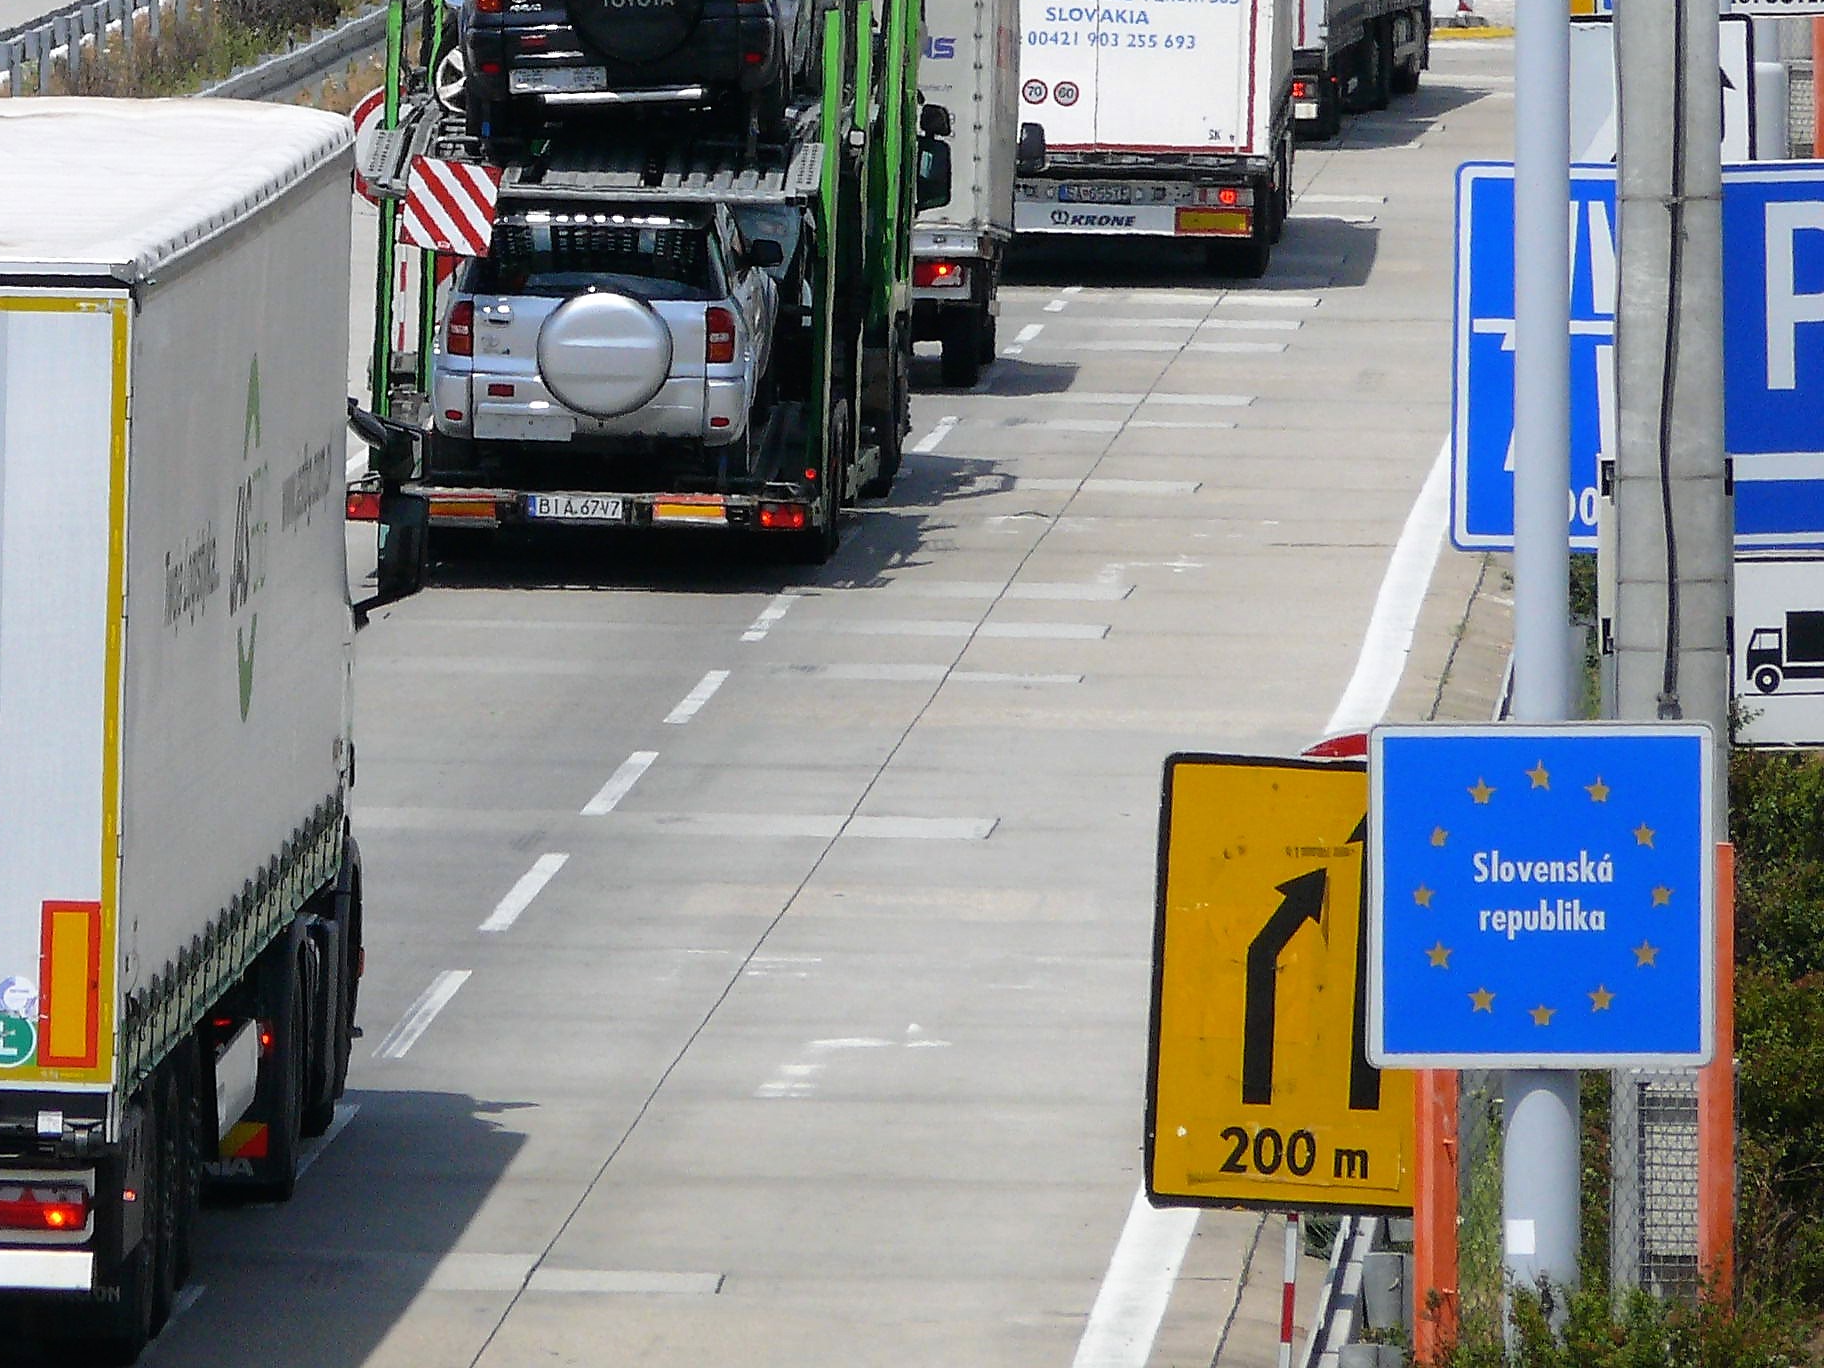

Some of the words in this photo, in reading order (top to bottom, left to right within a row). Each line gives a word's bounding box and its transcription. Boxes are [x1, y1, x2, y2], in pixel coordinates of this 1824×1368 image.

[1045, 7, 1150, 25] SLOVAKIA
[1028, 31, 1078, 46] 00421
[1087, 32, 1119, 47] 903
[1128, 33, 1157, 48] 255
[1164, 34, 1196, 50] 693
[1027, 85, 1043, 98] 70
[1071, 215, 1136, 226] KRONE
[1473, 850, 1613, 884] Slovenská
[1479, 899, 1606, 939] republika
[1219, 1127, 1318, 1176] 200
[1334, 1144, 1369, 1179] m
